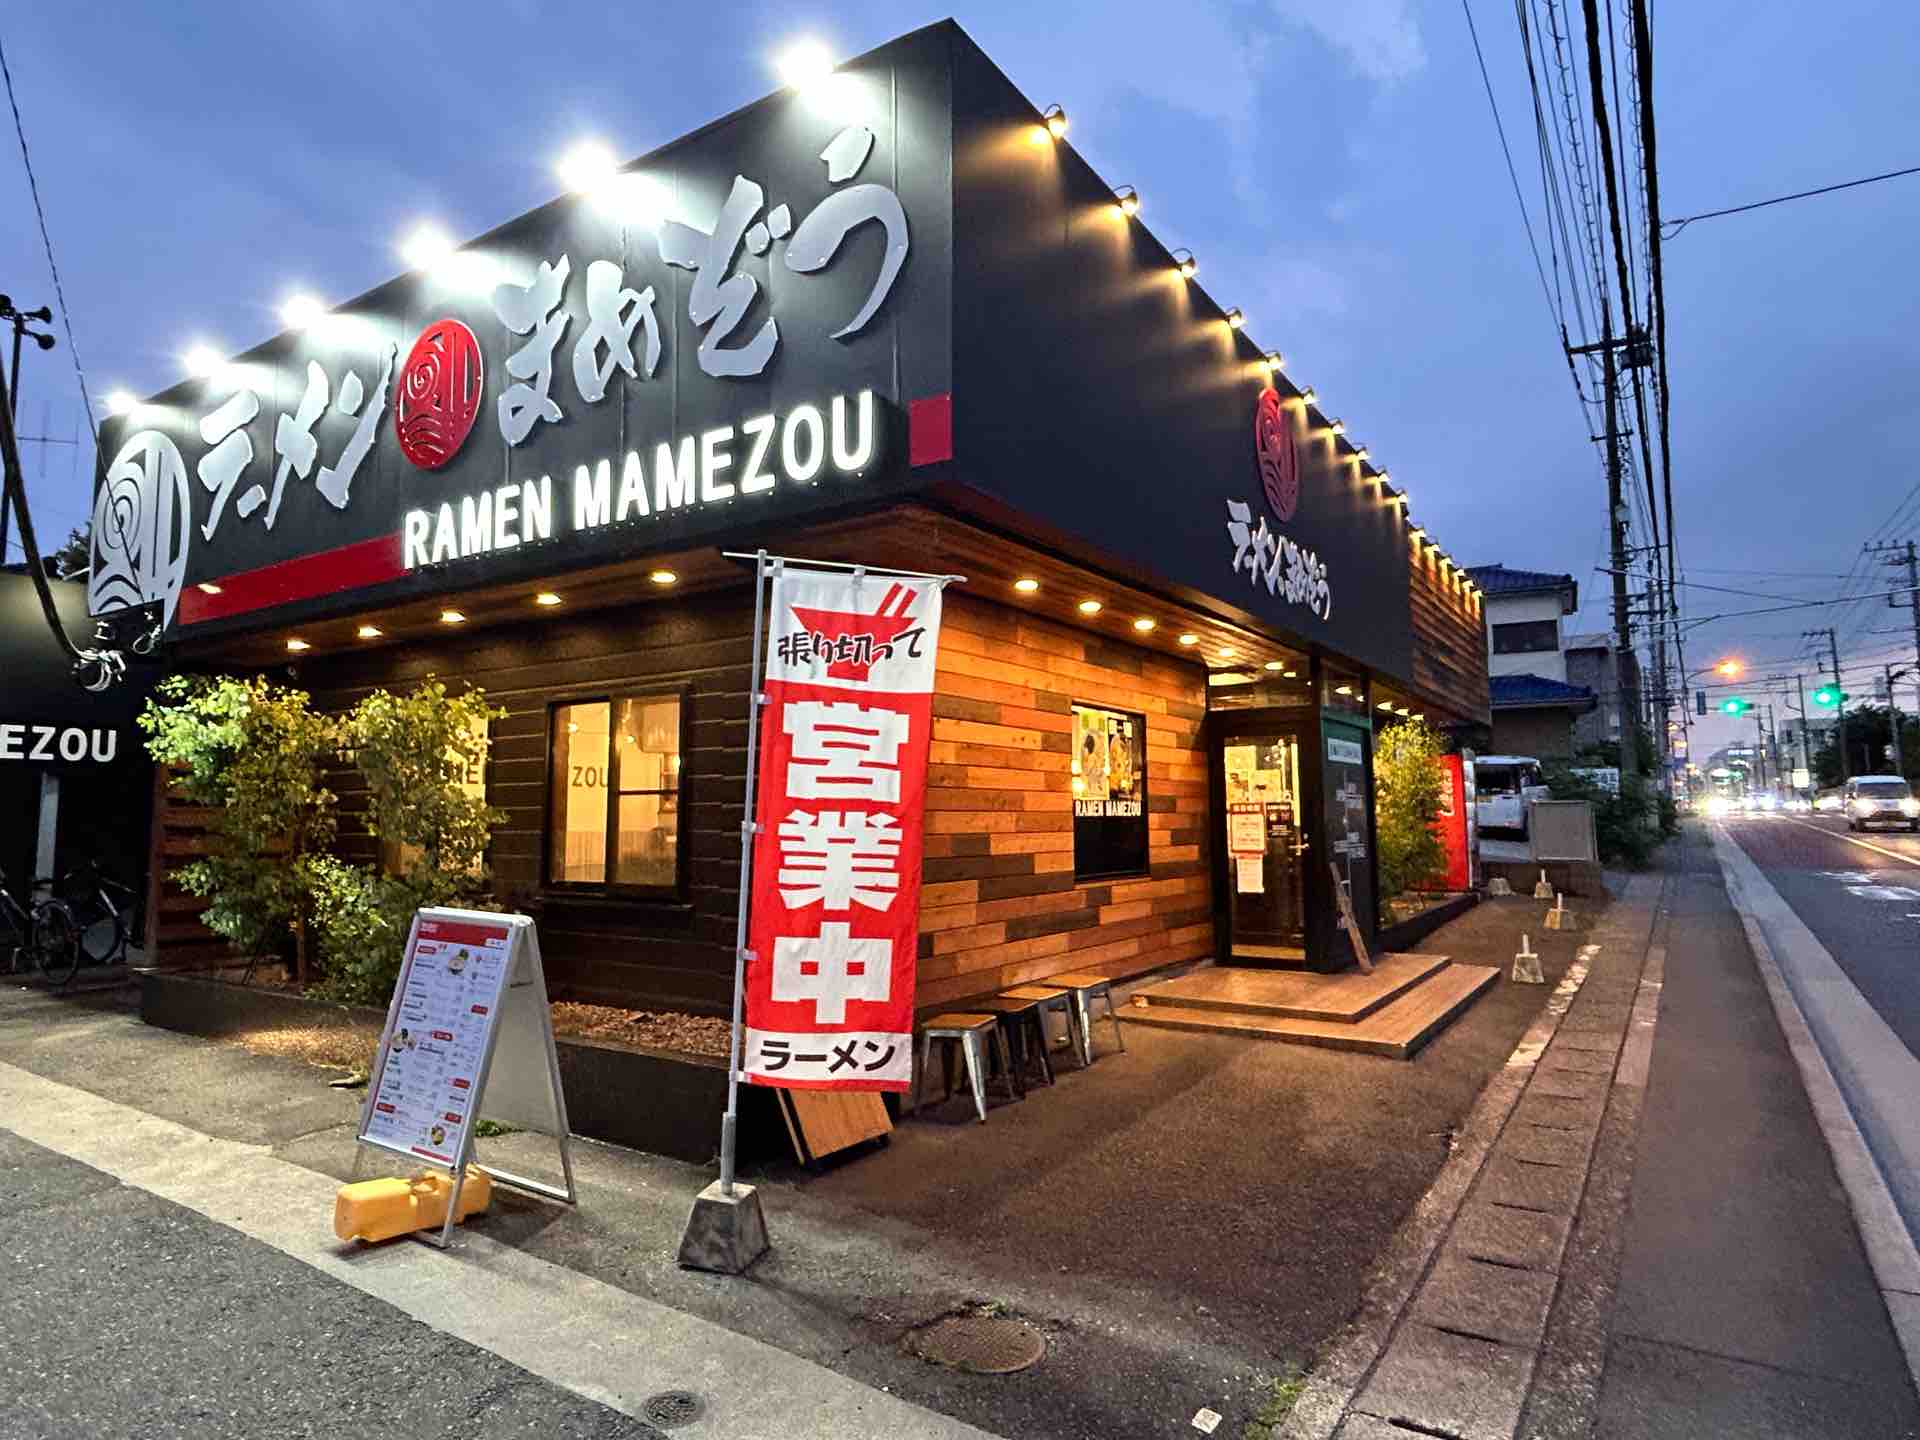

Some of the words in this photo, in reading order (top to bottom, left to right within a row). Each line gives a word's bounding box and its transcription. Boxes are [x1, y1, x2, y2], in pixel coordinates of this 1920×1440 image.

[403, 475, 553, 569] RAMEN
[574, 391, 874, 530] MAMEZOU
[777, 626, 926, 667] 張り切って
[0, 724, 117, 762] EZOU
[1075, 800, 1104, 816] RAMEN
[1106, 800, 1142, 816] MAMEZOU
[771, 701, 910, 1025] 営業中
[760, 1039, 896, 1074] ラーメン
